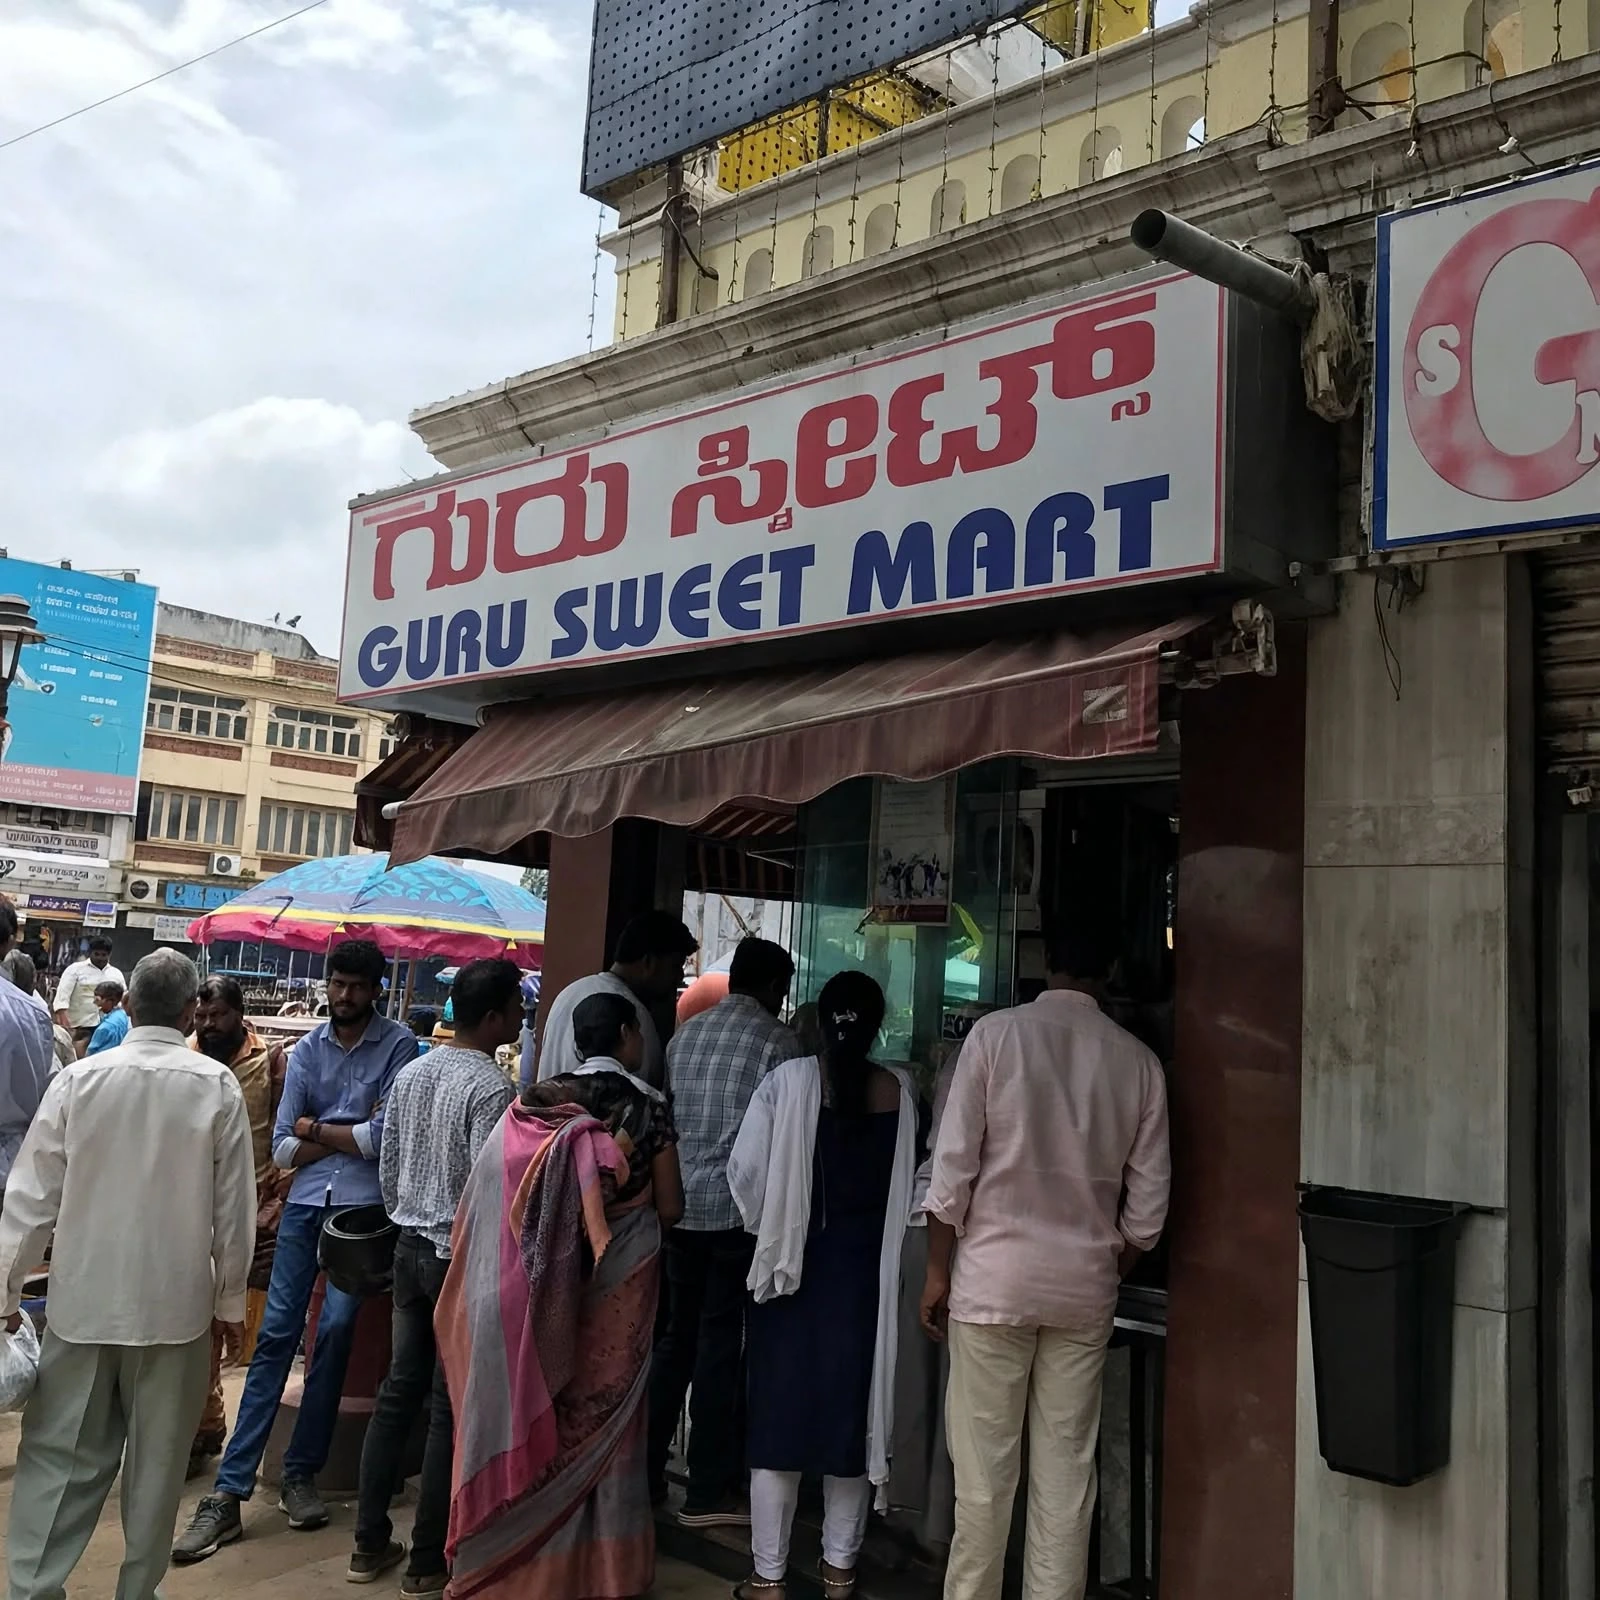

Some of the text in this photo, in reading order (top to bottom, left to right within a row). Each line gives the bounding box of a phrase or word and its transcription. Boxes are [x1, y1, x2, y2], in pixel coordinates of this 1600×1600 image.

[358, 473, 1170, 688] GURU SWEET MART
[374, 452, 629, 601] ಗುರು
